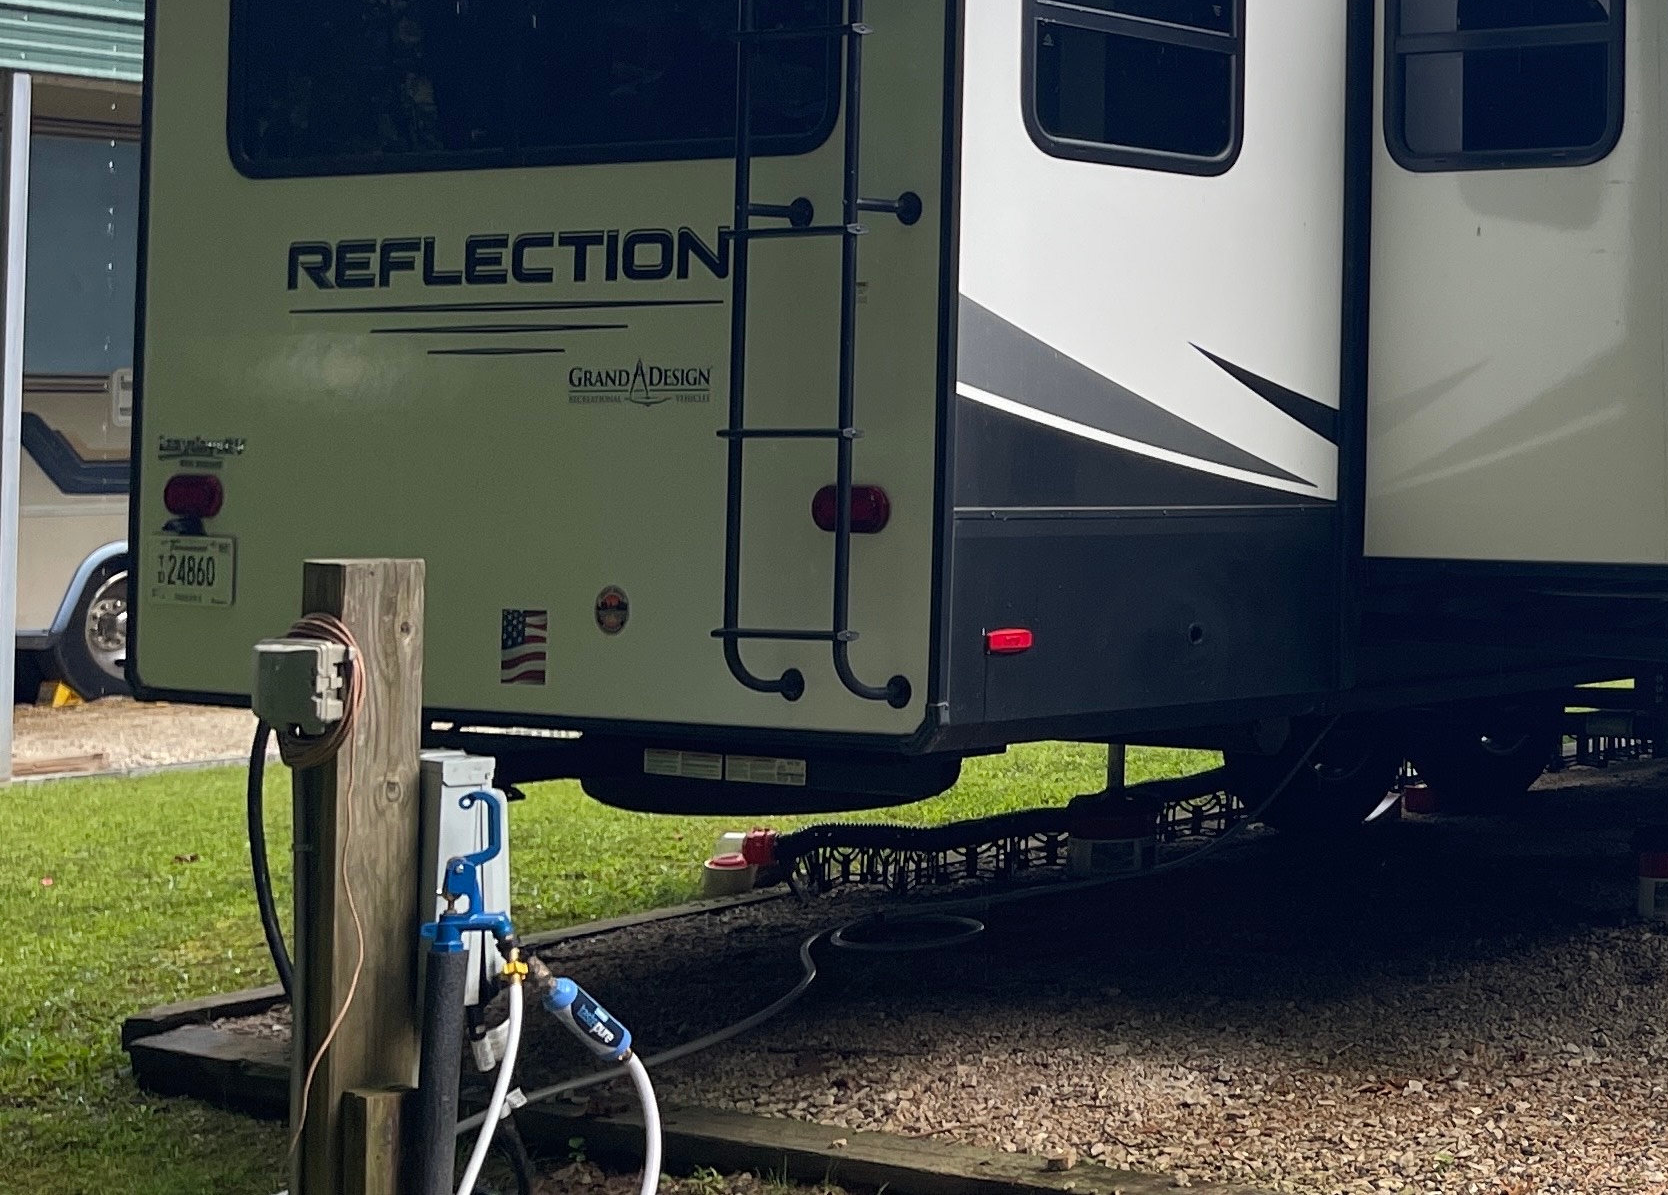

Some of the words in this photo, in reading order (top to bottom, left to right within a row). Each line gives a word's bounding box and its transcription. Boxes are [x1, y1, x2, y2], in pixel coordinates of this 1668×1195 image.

[286, 225, 731, 291] REFLECTION
[568, 367, 630, 388] GRAND
[649, 366, 711, 387] DESIGN
[167, 554, 216, 587] 24860
